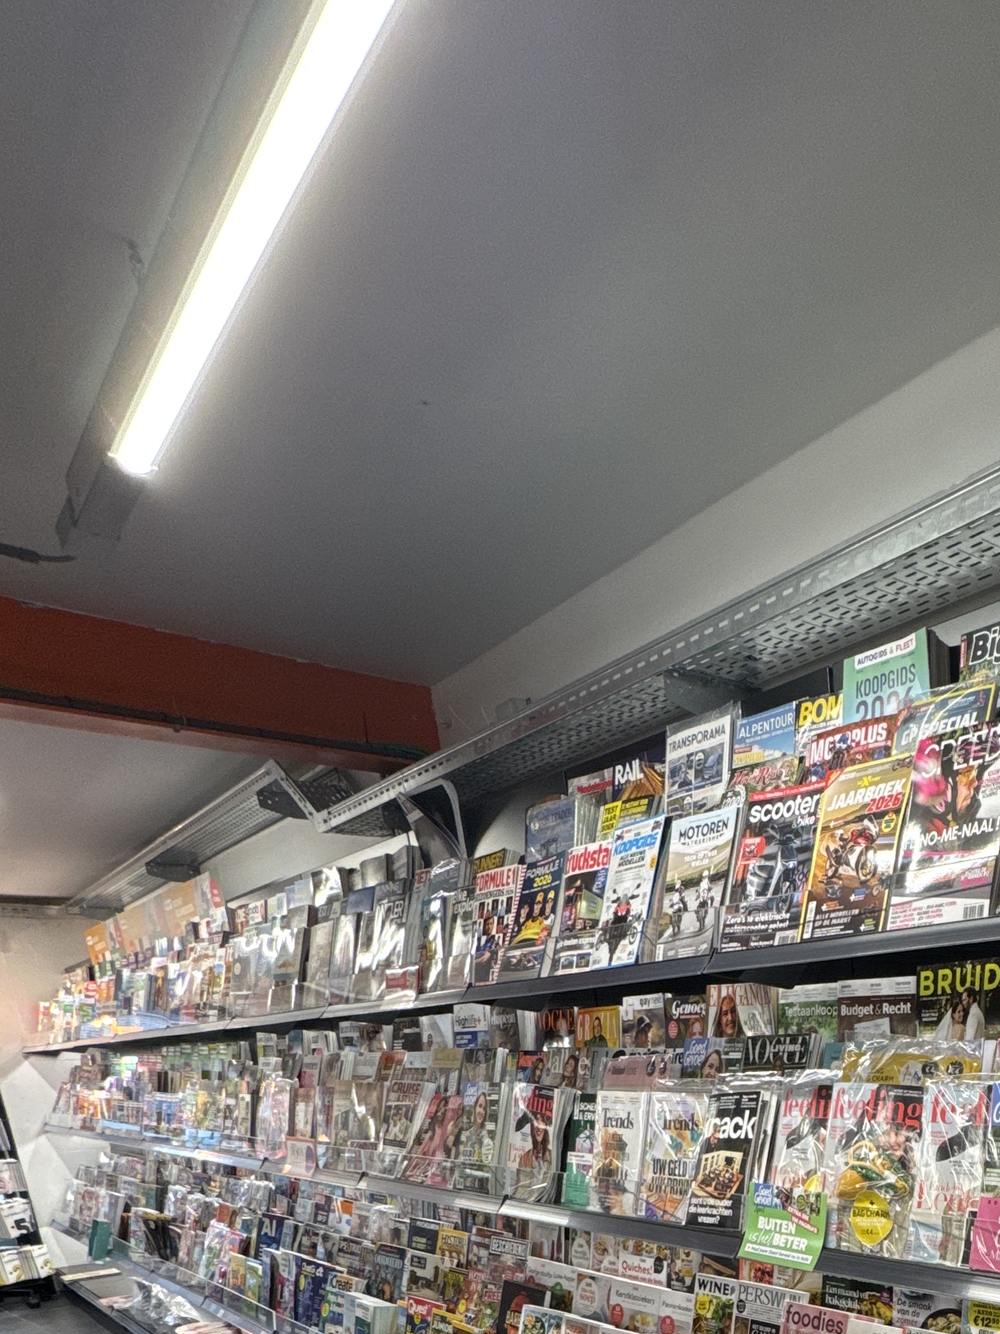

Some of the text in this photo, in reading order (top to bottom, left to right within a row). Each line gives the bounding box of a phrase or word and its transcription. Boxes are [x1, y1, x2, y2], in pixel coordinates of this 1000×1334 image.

[856, 638, 915, 667] AUTOGIDS FLEET
[855, 663, 917, 699] KOOPGIDS
[668, 723, 726, 752] TRANSPORAMA
[615, 758, 644, 785] RAIL
[828, 777, 907, 812] JAARBOEK
[865, 793, 903, 815] 2026
[750, 794, 820, 824] scooter
[679, 816, 730, 842] MOTOREN
[919, 962, 1000, 997] BRUID
[840, 1002, 911, 1018] Budget Recht
[603, 1108, 634, 1130] Trends
[758, 1216, 797, 1235] BUITEN
[773, 1233, 808, 1251] BETER
[698, 1278, 730, 1296] WINE
